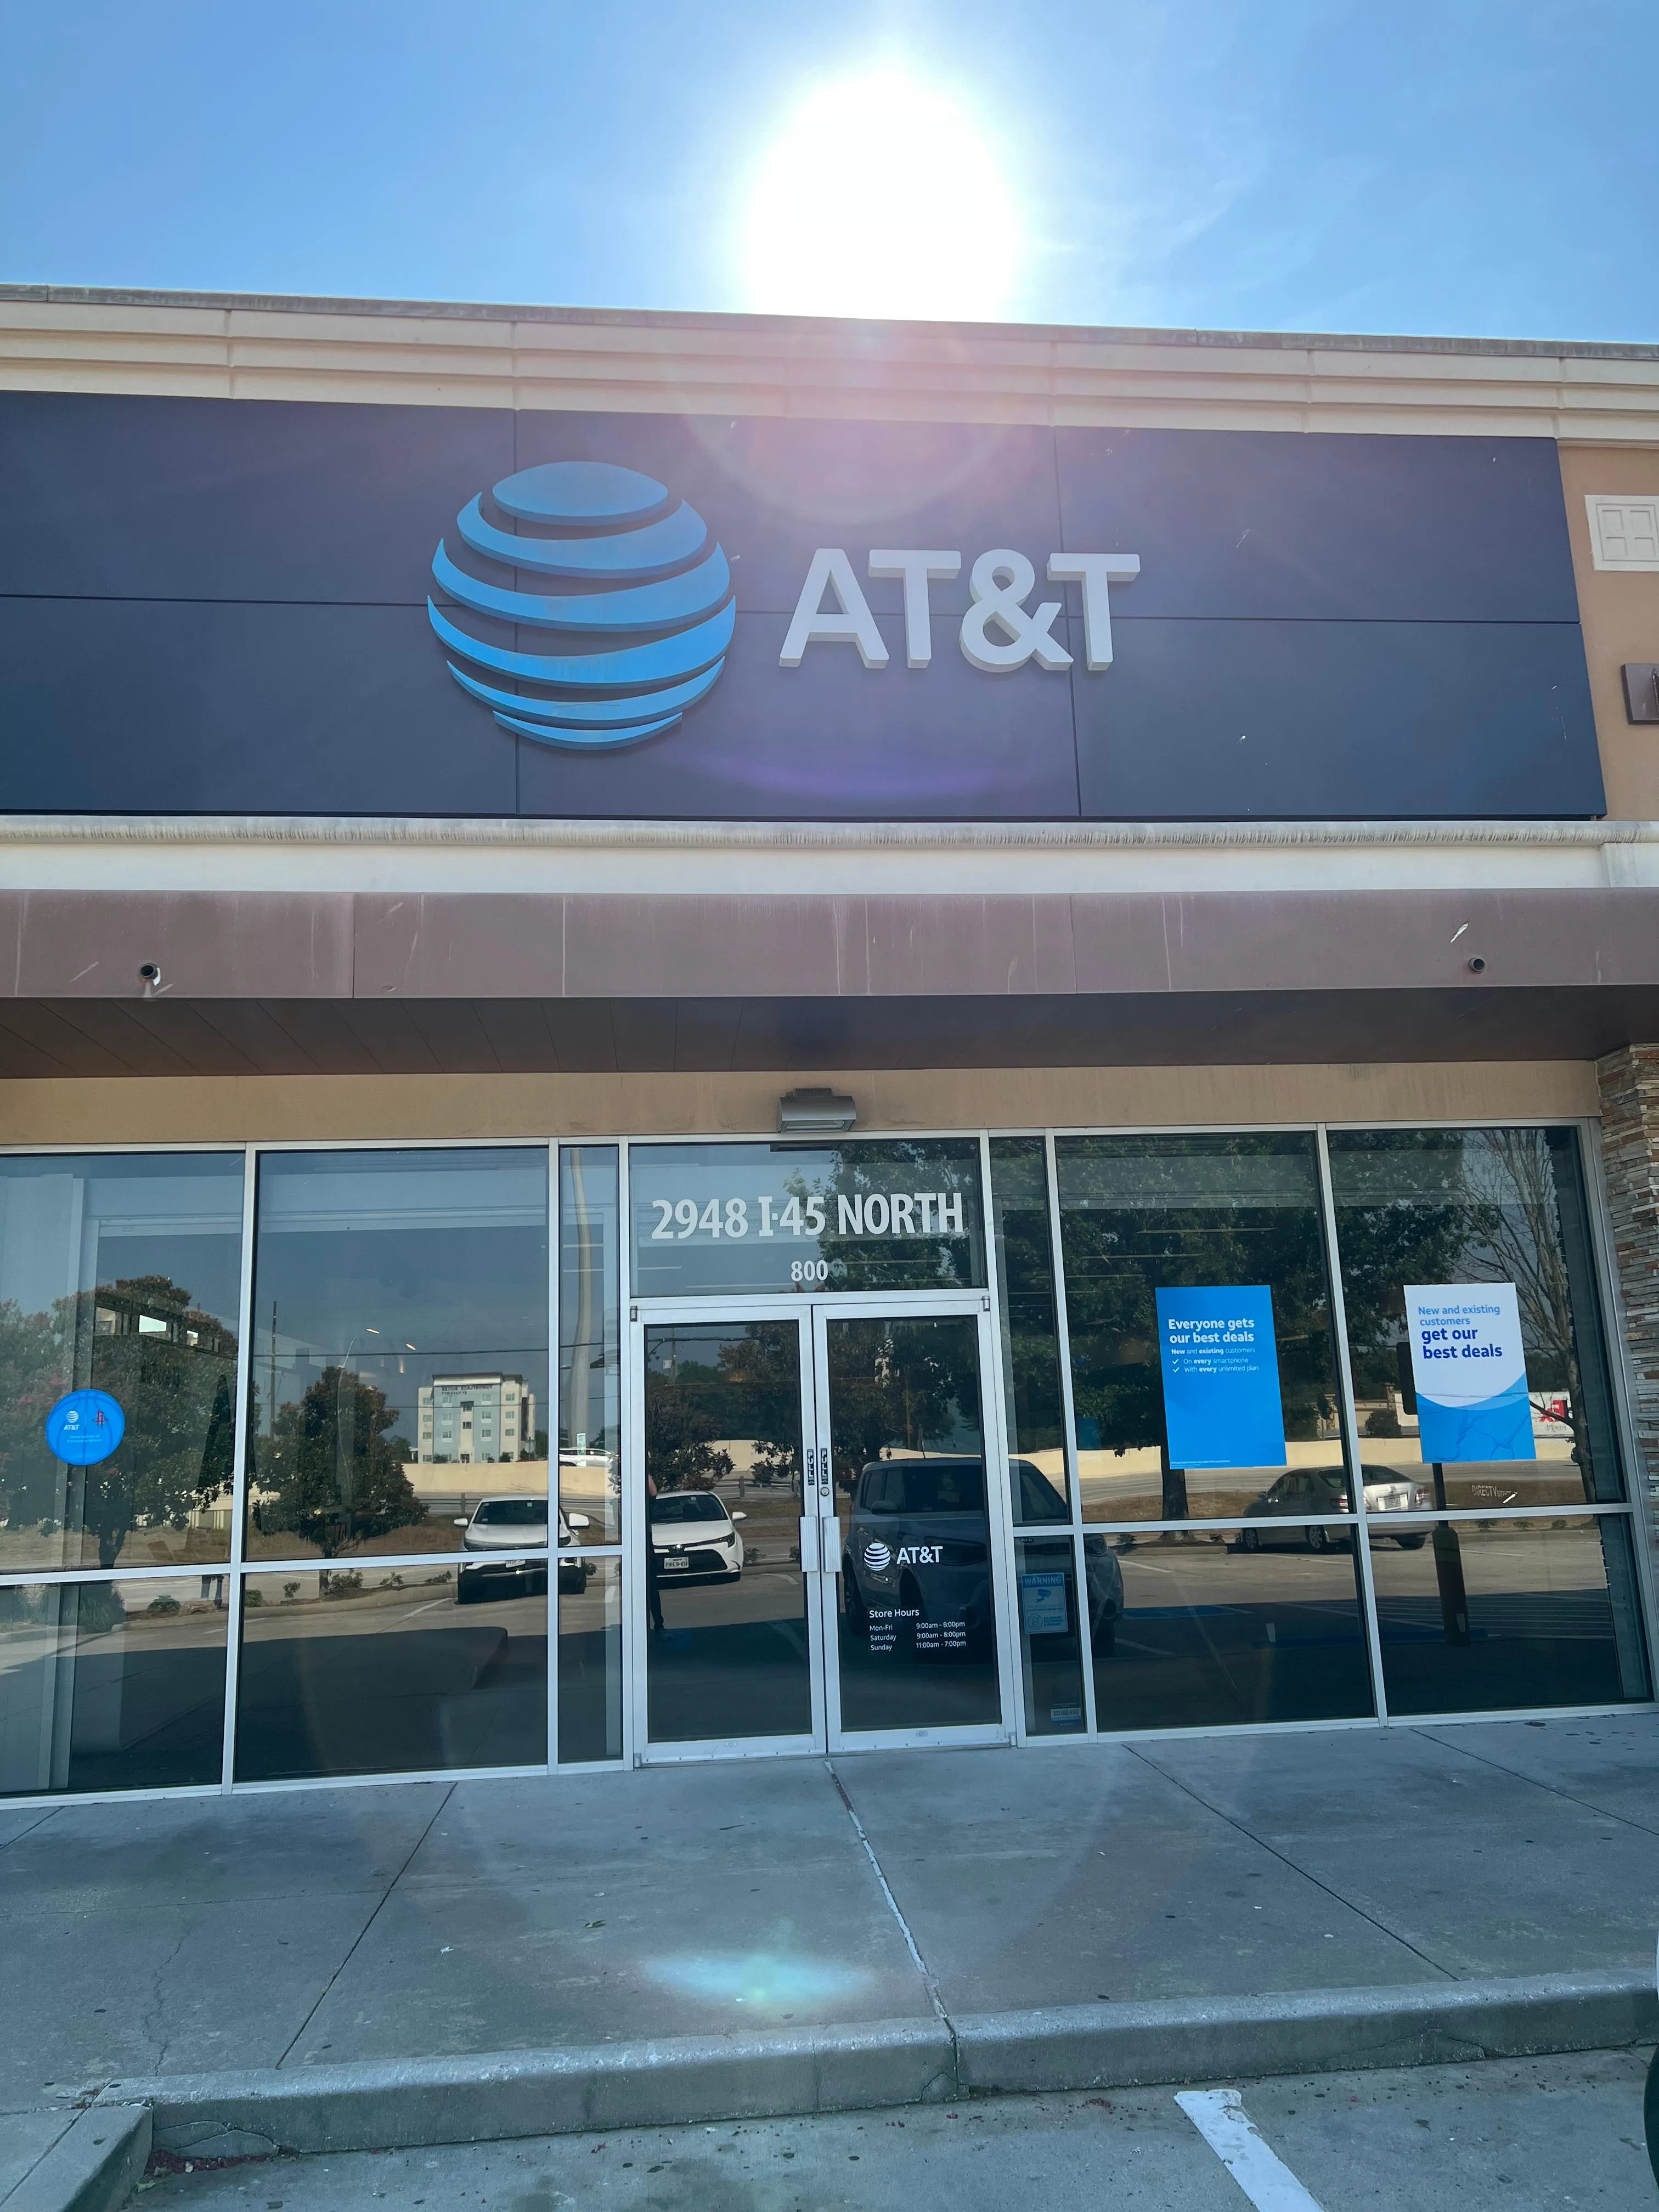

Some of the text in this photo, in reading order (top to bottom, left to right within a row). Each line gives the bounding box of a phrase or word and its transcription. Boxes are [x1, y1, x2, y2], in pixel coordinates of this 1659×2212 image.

[778, 548, 1141, 672] AT&T
[651, 1198, 748, 1239] 2948
[837, 1193, 963, 1235] NORTH
[791, 1260, 828, 1282] 800
[1442, 1306, 1460, 1314] and
[1462, 1305, 1500, 1315] existing
[1168, 1318, 1255, 1331] Everyone gets
[1169, 1331, 1255, 1344] our best deals
[1421, 1328, 1478, 1344] get our
[1423, 1344, 1503, 1359] best deals
[896, 1546, 943, 1564] AT&T
[1024, 1576, 1062, 1585] WARNING
[869, 1609, 919, 1618] Store Hours
